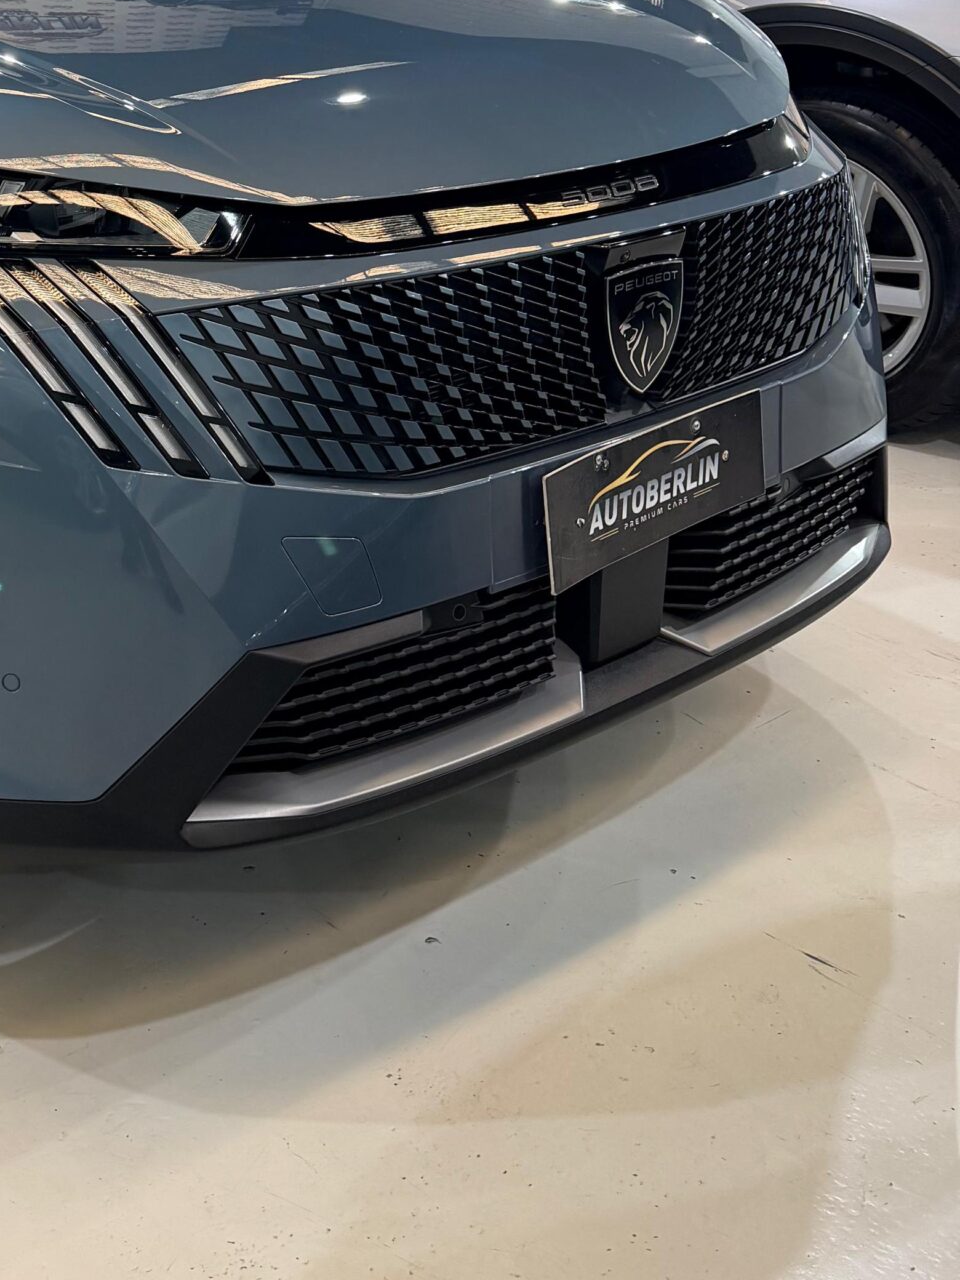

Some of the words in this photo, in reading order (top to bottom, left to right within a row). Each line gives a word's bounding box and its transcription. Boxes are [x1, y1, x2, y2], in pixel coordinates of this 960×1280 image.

[614, 270, 678, 295] PEUGEOT
[589, 452, 720, 535] AUTOBERLIN
[624, 508, 664, 531] PREMIUM
[667, 496, 689, 511] CARS
